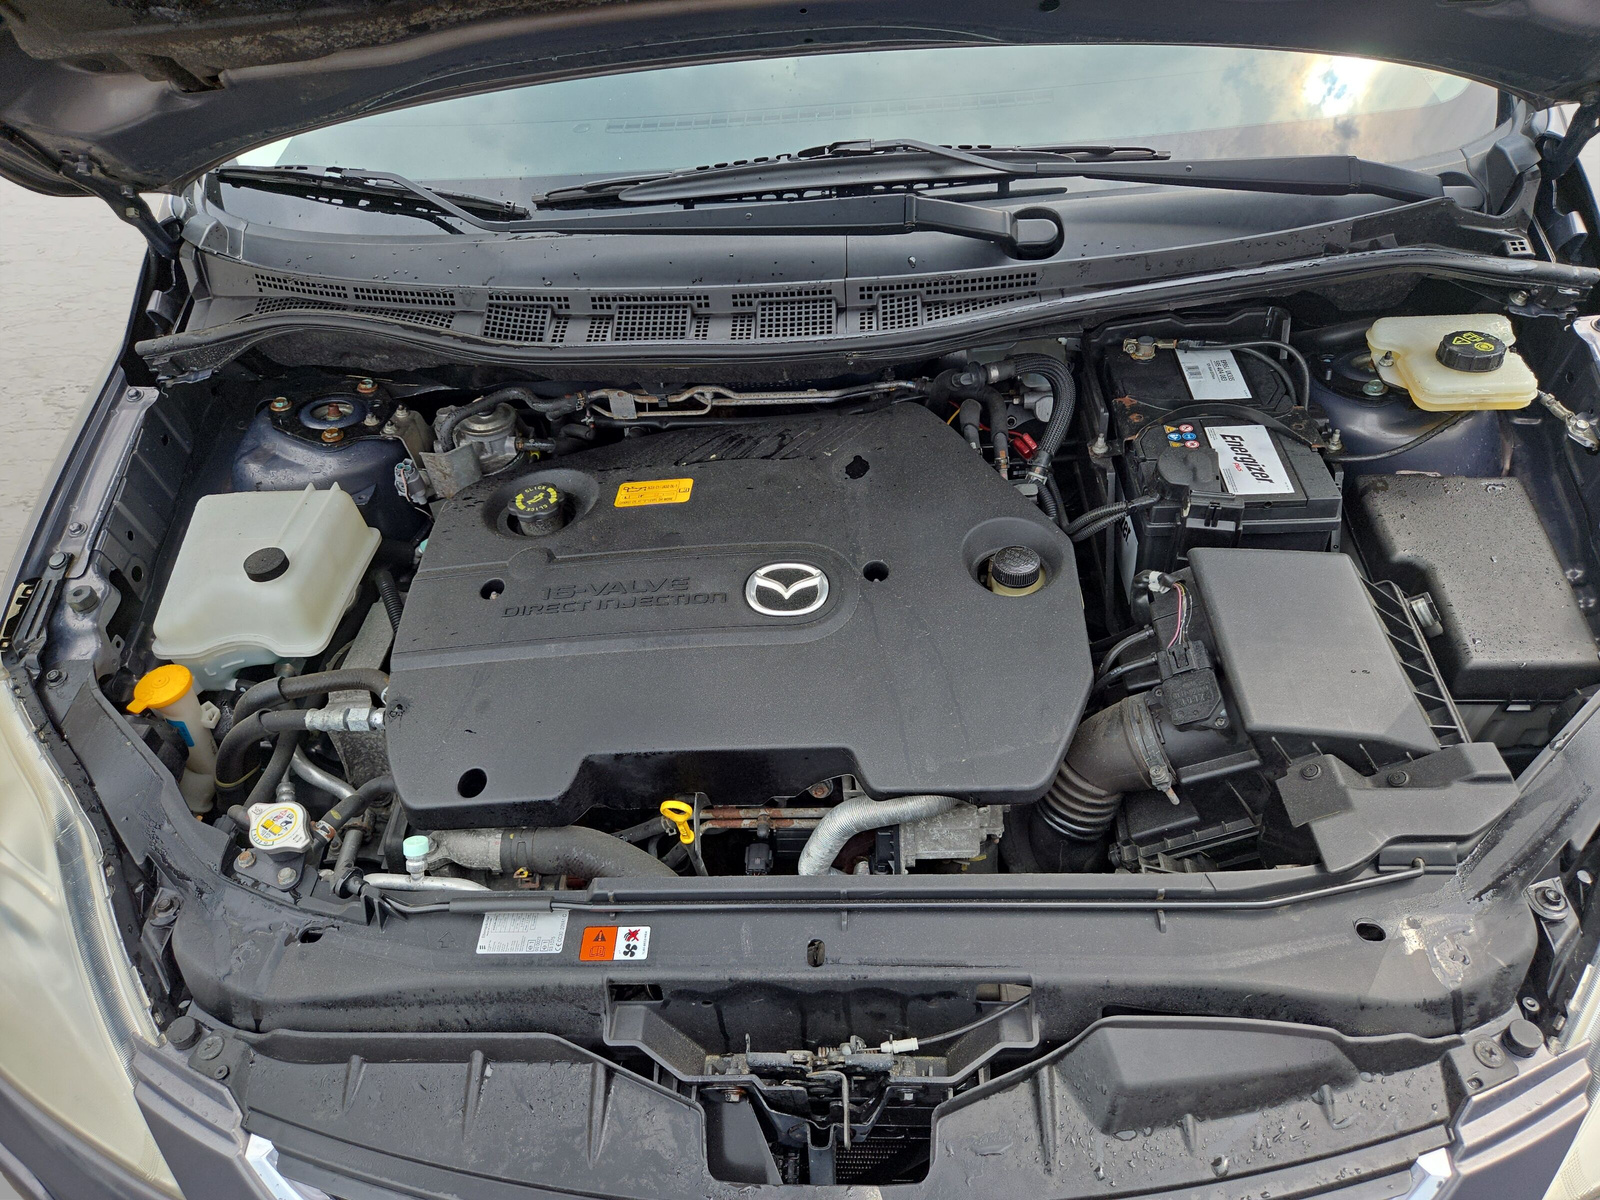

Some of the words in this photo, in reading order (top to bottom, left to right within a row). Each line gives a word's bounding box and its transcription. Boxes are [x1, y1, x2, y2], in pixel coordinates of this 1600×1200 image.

[1219, 434, 1274, 484] Energizer
[543, 577, 690, 600] 16-VALVE
[502, 600, 591, 617] DIRECT
[596, 592, 727, 611] INJECTION
